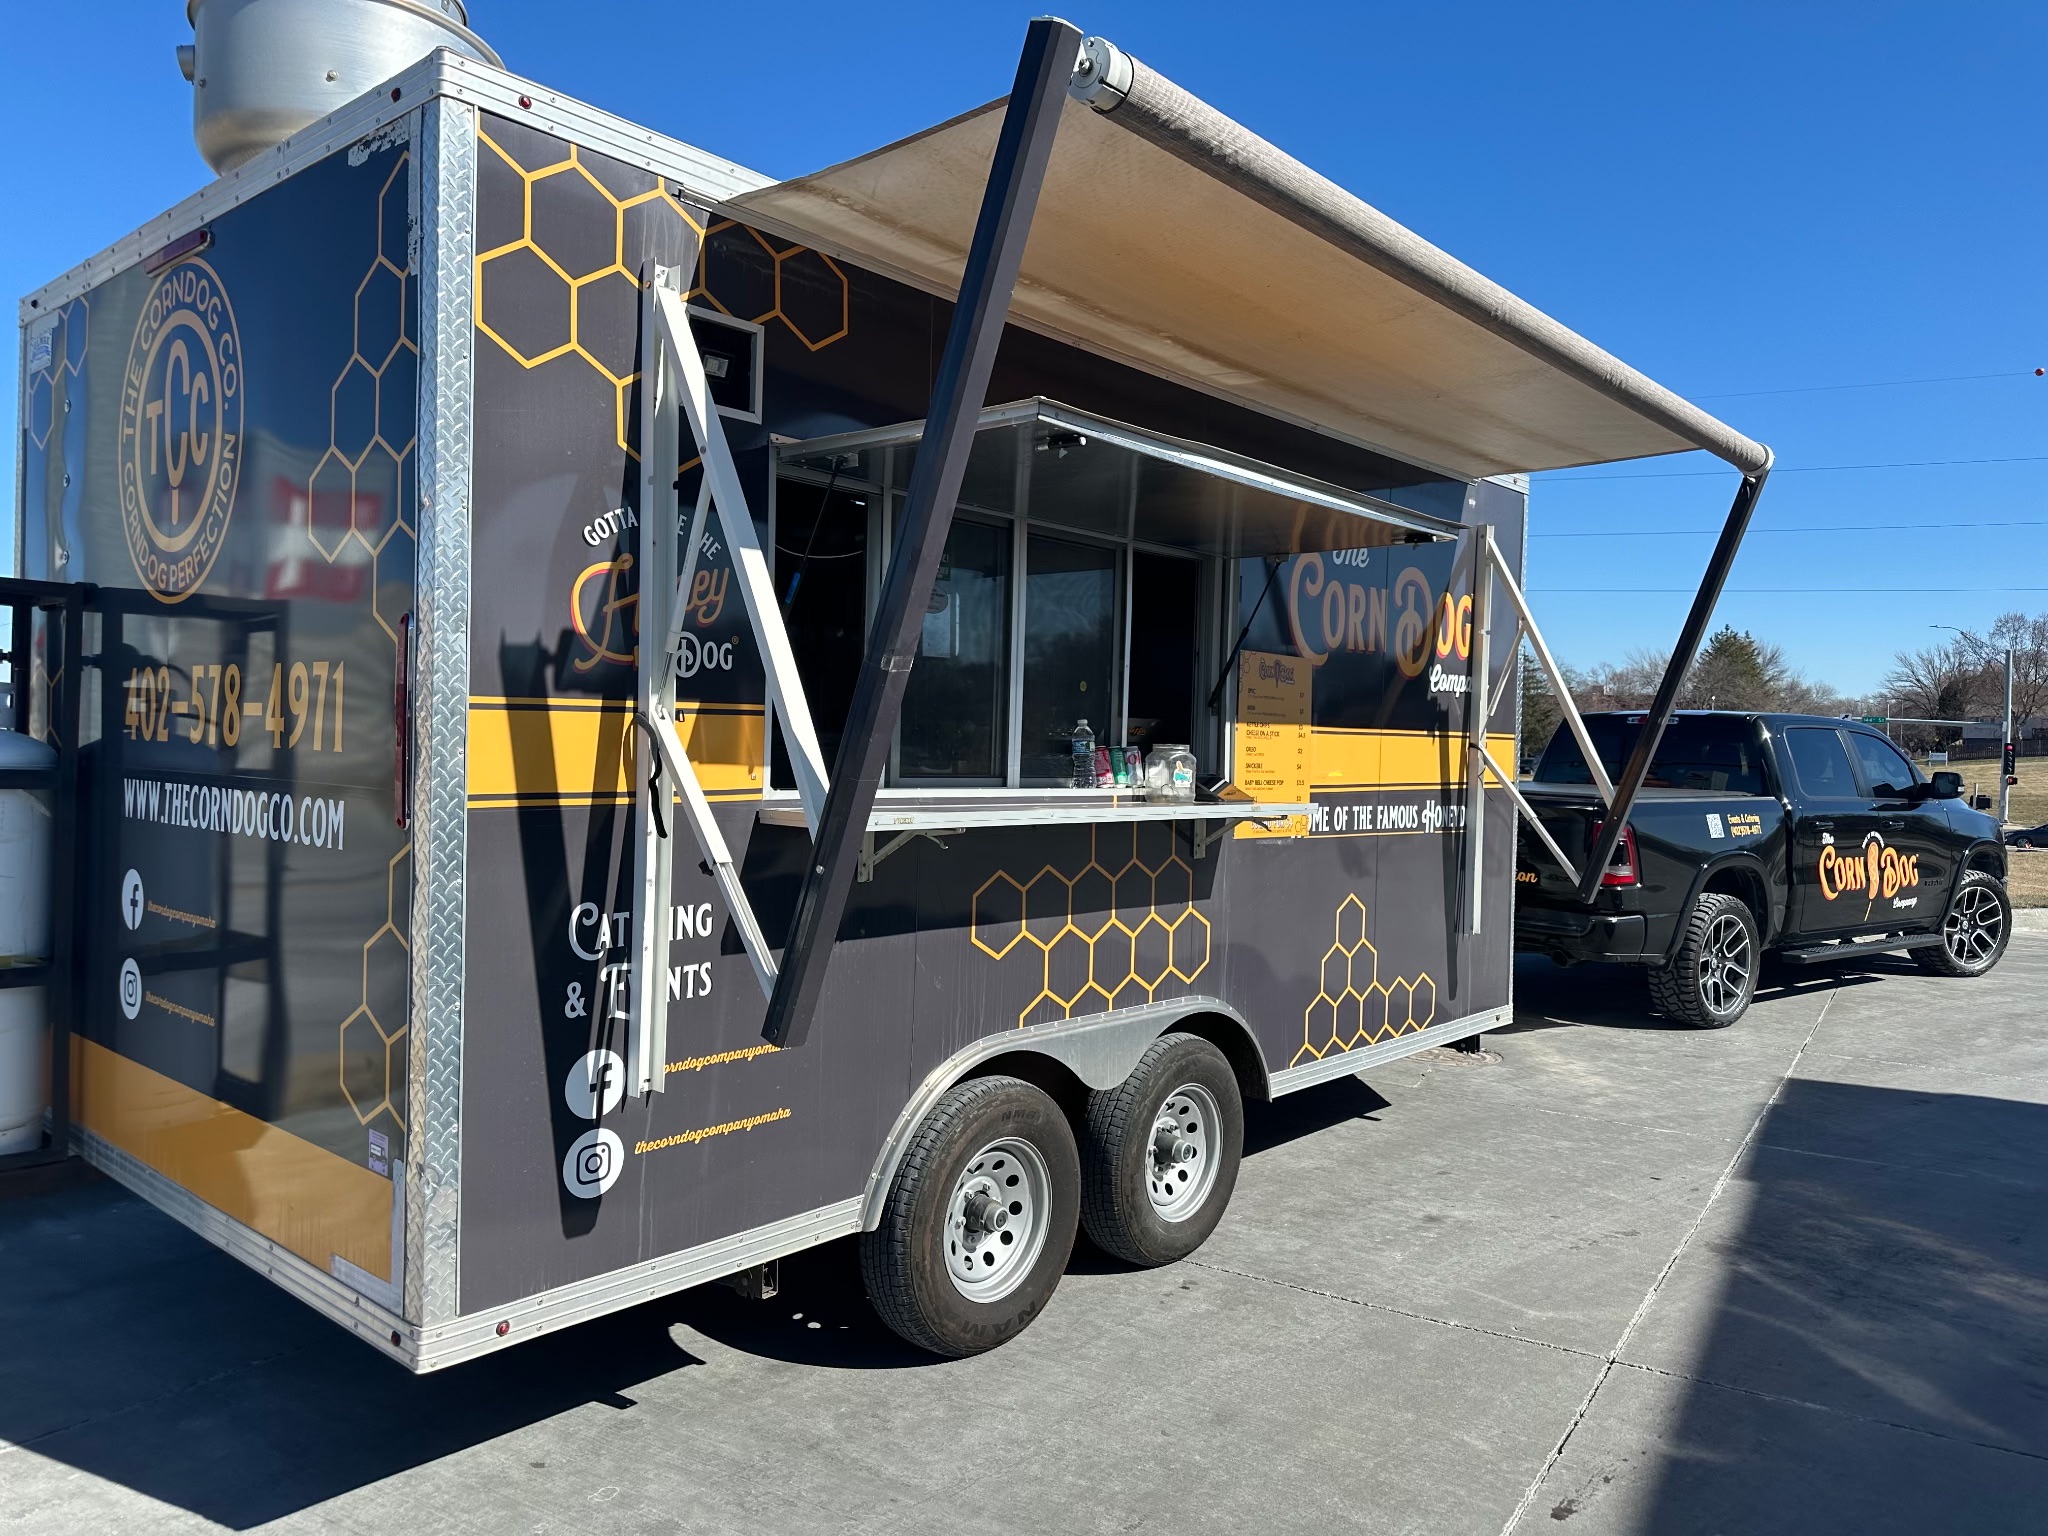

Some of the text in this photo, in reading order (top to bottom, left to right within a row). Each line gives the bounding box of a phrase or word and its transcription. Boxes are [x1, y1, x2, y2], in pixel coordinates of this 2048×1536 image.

[123, 358, 143, 443] THE
[140, 271, 222, 351] CORNDOG
[124, 433, 236, 592] CORNDOG PERFECTION
[582, 506, 638, 546] GOTTA
[699, 531, 722, 560] HE
[1288, 551, 1472, 679] CORN DOG
[123, 660, 344, 753] 402-578-4971
[1428, 663, 1472, 698] Compa
[123, 778, 345, 850] WWW.THECORNDOGCO.COM
[1334, 806, 1348, 831] OF
[1353, 805, 1372, 830] THE
[1376, 805, 1418, 830] FAMOUS
[1819, 845, 1919, 901] CORN DOG
[568, 902, 713, 960] CATING
[564, 961, 712, 1019] & ENTS
[635, 1106, 791, 1155] thecorndogcompanyomaha
